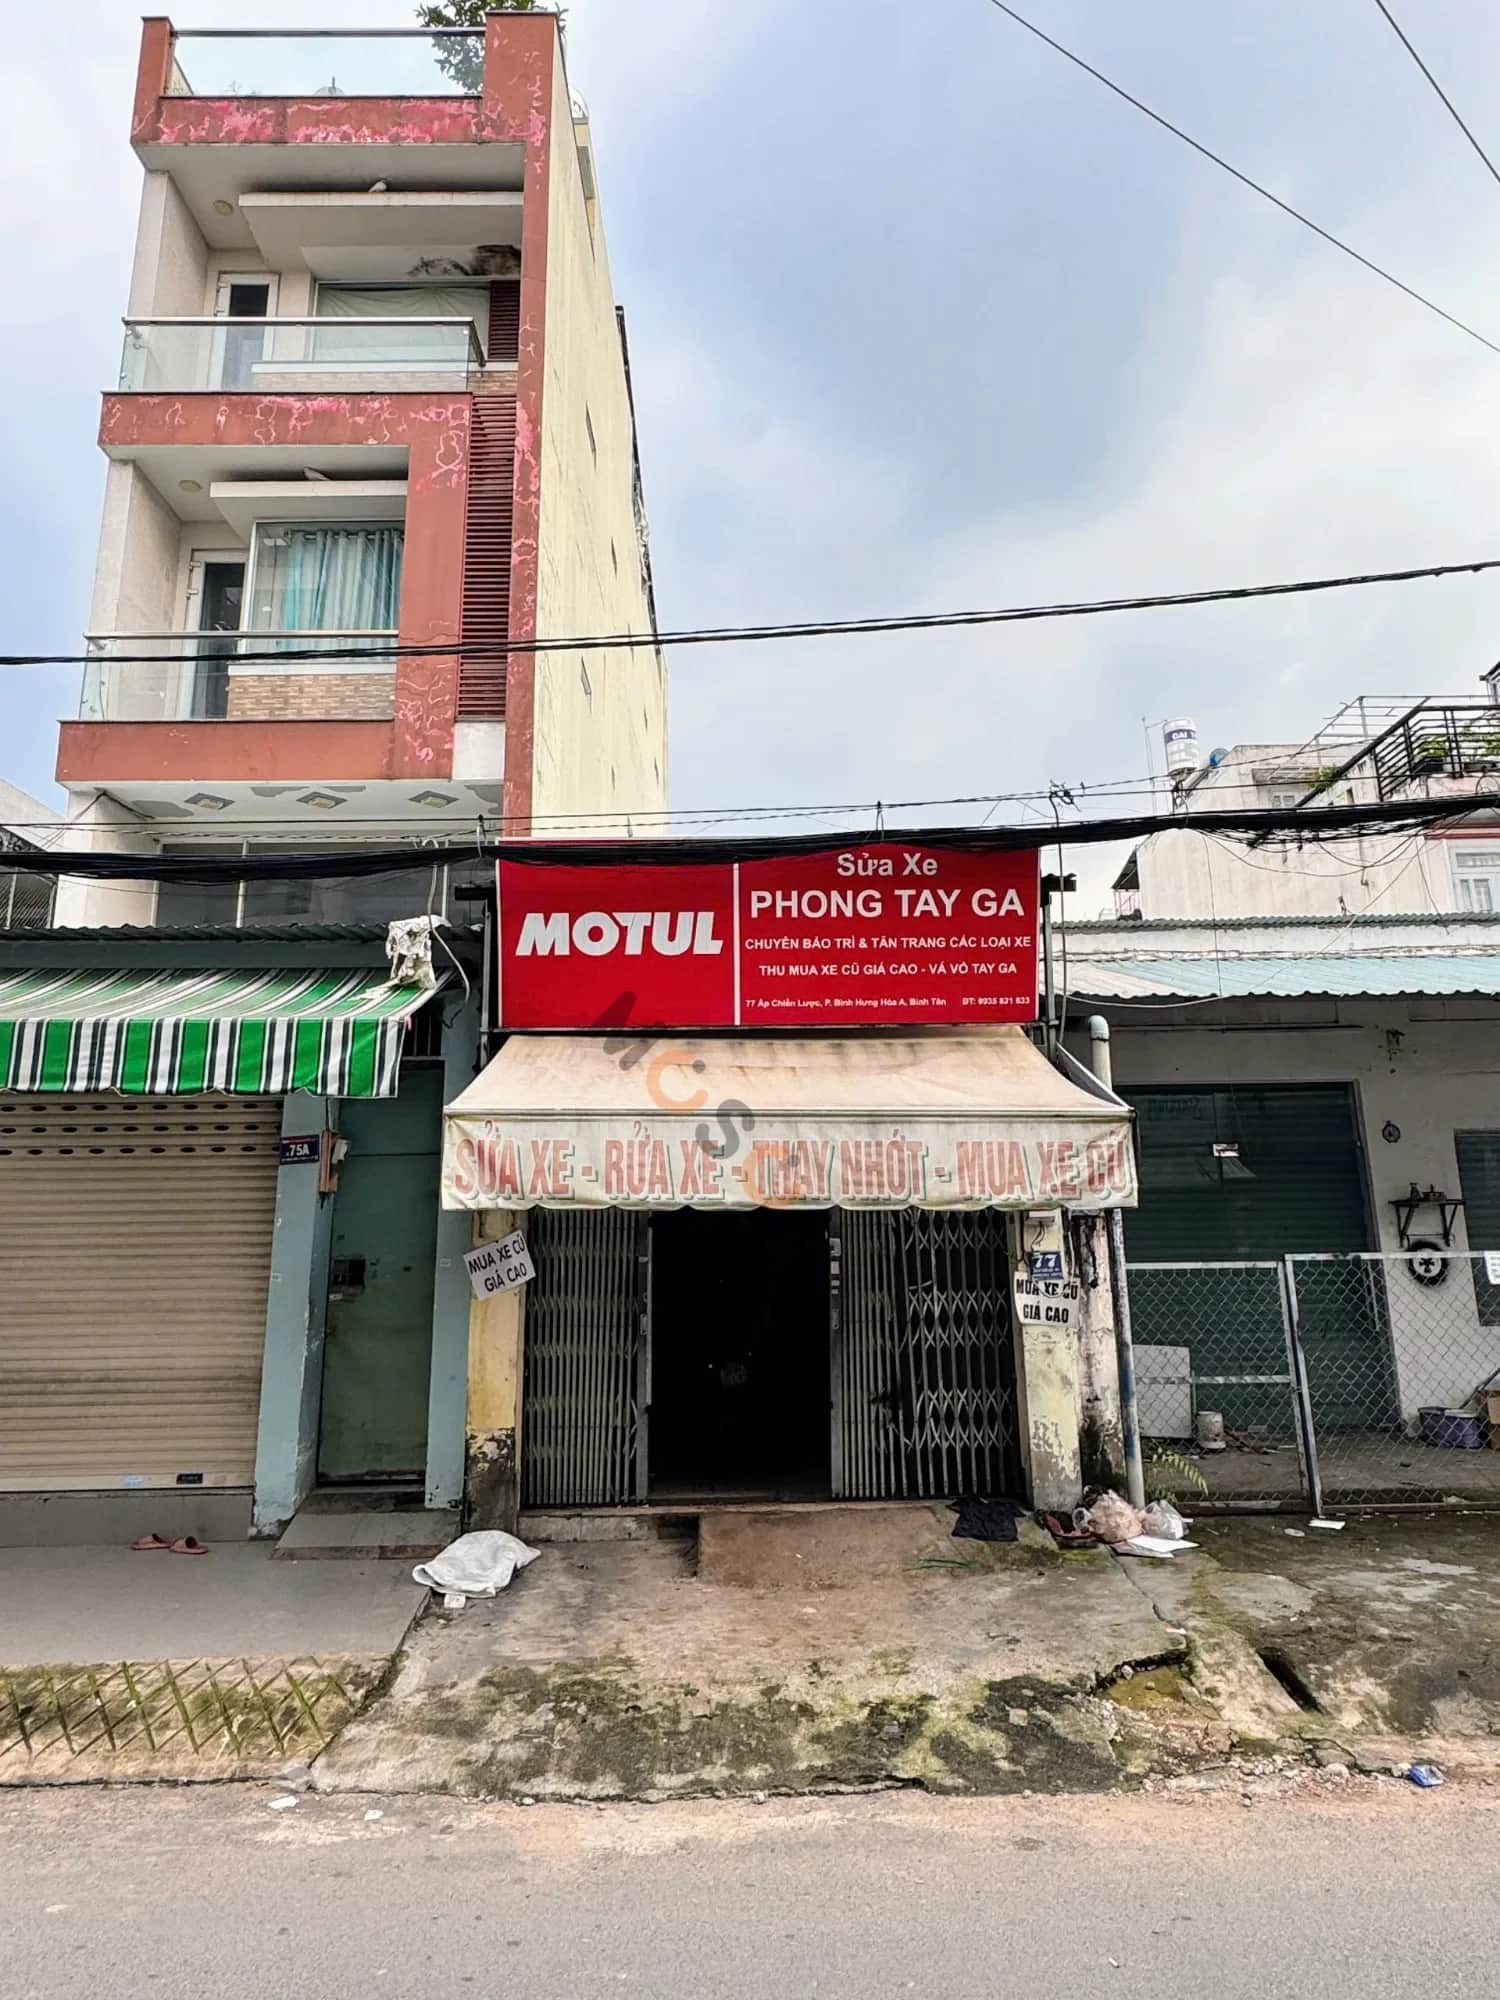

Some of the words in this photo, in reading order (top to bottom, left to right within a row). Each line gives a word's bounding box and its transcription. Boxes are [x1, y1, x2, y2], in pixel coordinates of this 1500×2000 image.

[837, 852, 893, 877] Sửa
[902, 853, 938, 876] Xe
[751, 889, 883, 918] PHONG
[894, 889, 961, 918] TAY
[971, 888, 1025, 917] GA
[515, 911, 724, 956] MOTUL
[745, 936, 799, 949] CHUYÊN
[859, 938, 868, 949] &
[901, 937, 946, 948] TRANG
[950, 934, 977, 947] CÁC
[981, 936, 1011, 949] LOẠI
[1014, 936, 1031, 947] XE
[759, 965, 785, 976] THU
[789, 965, 818, 976] MUA
[821, 965, 838, 976] XE
[841, 962, 860, 975] CŨ
[863, 961, 886, 975] GIÁ
[889, 963, 918, 975] CAO
[971, 963, 995, 974] TAY
[998, 963, 1017, 974] GA
[455, 1120, 520, 1195] SỬA
[529, 1139, 572, 1195] XE
[605, 1120, 670, 1195] RỬA
[679, 1139, 722, 1195] XE
[752, 1139, 831, 1196] THAY
[840, 1128, 925, 1196] NHỚT
[956, 1141, 1030, 1196] MUA
[1038, 1140, 1078, 1196] XE
[468, 1252, 497, 1275] MUA
[496, 1244, 513, 1263] XE
[1033, 1254, 1057, 1268] 77
[484, 1269, 506, 1292] GIÁ
[506, 1262, 528, 1282] CAO
[1016, 1279, 1040, 1297] MUA
[1044, 1282, 1060, 1296] XE
[1023, 1301, 1041, 1321] GIÁ
[1045, 1305, 1069, 1323] CAO
